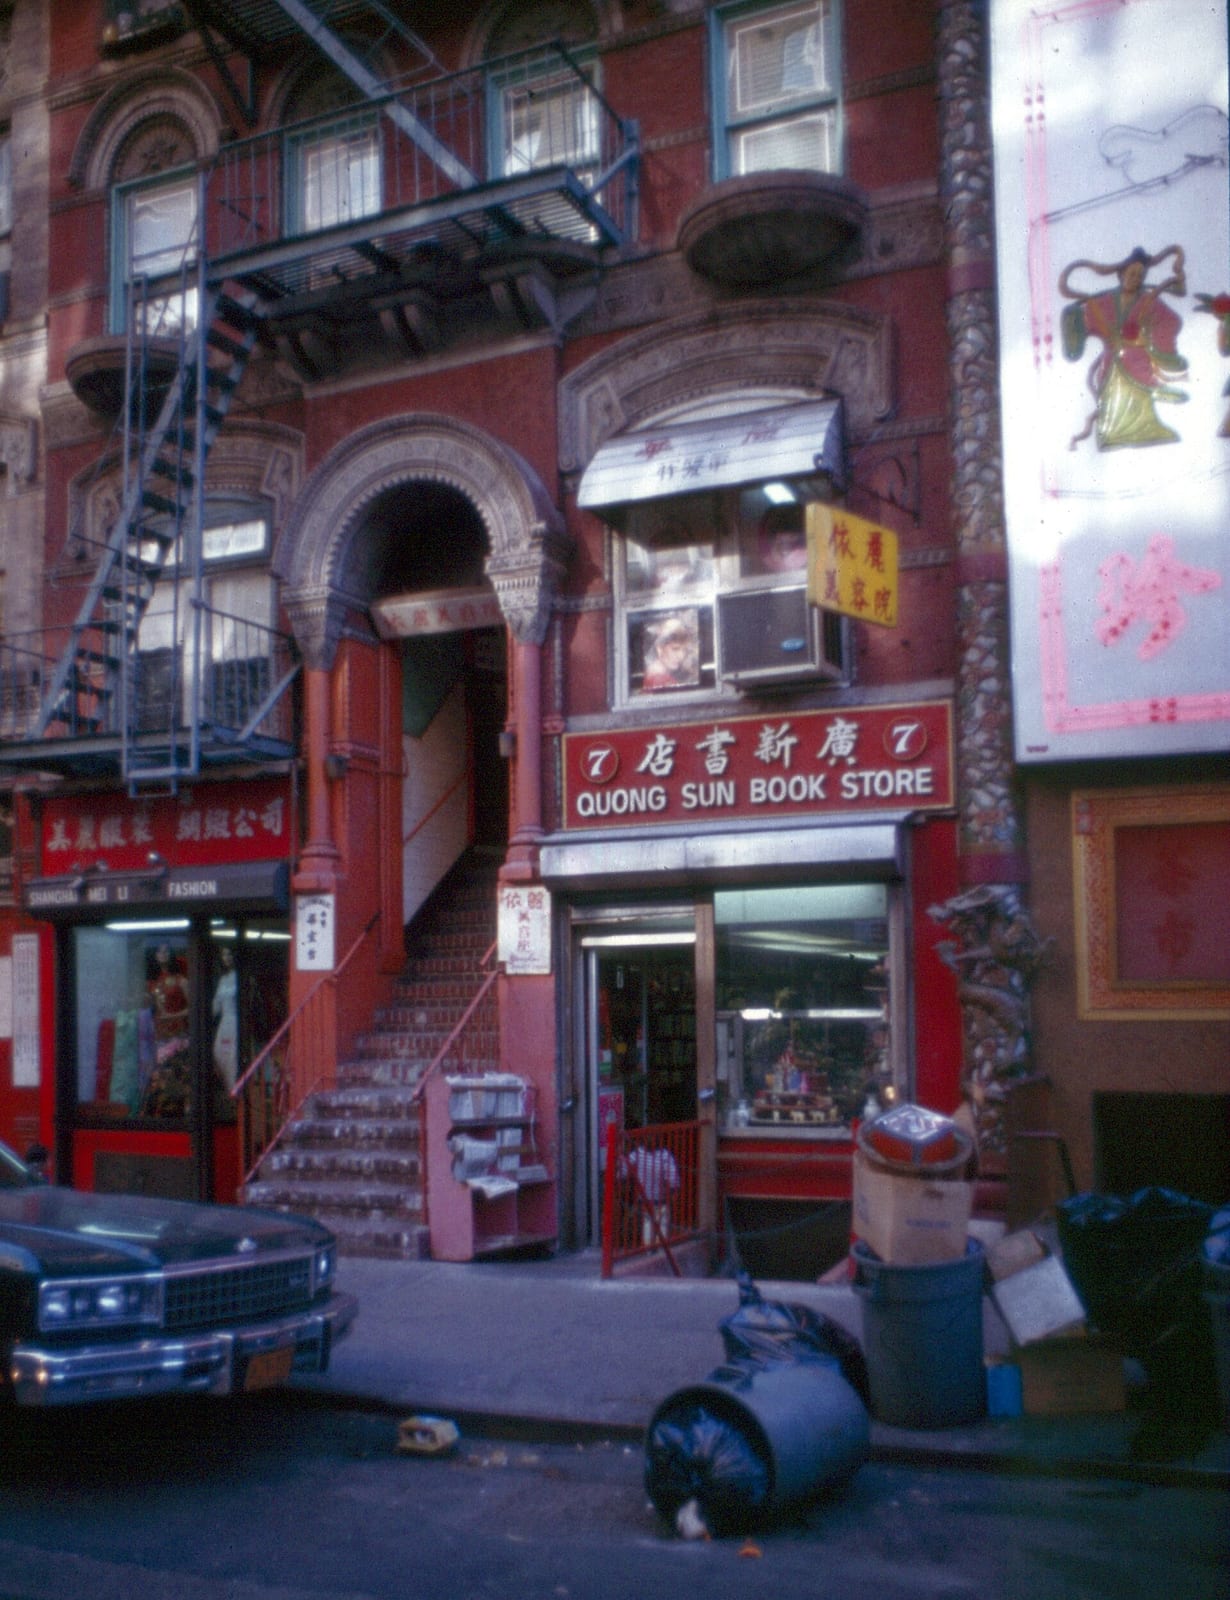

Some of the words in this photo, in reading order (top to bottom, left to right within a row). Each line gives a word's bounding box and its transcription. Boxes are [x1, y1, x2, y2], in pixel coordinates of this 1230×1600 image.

[891, 723, 919, 754] 7
[587, 748, 612, 777] 7
[576, 785, 667, 818] QUONG
[681, 780, 735, 810] SUN
[749, 773, 826, 803] BOOK
[840, 766, 934, 799] STORE
[168, 880, 217, 897] FASHION
